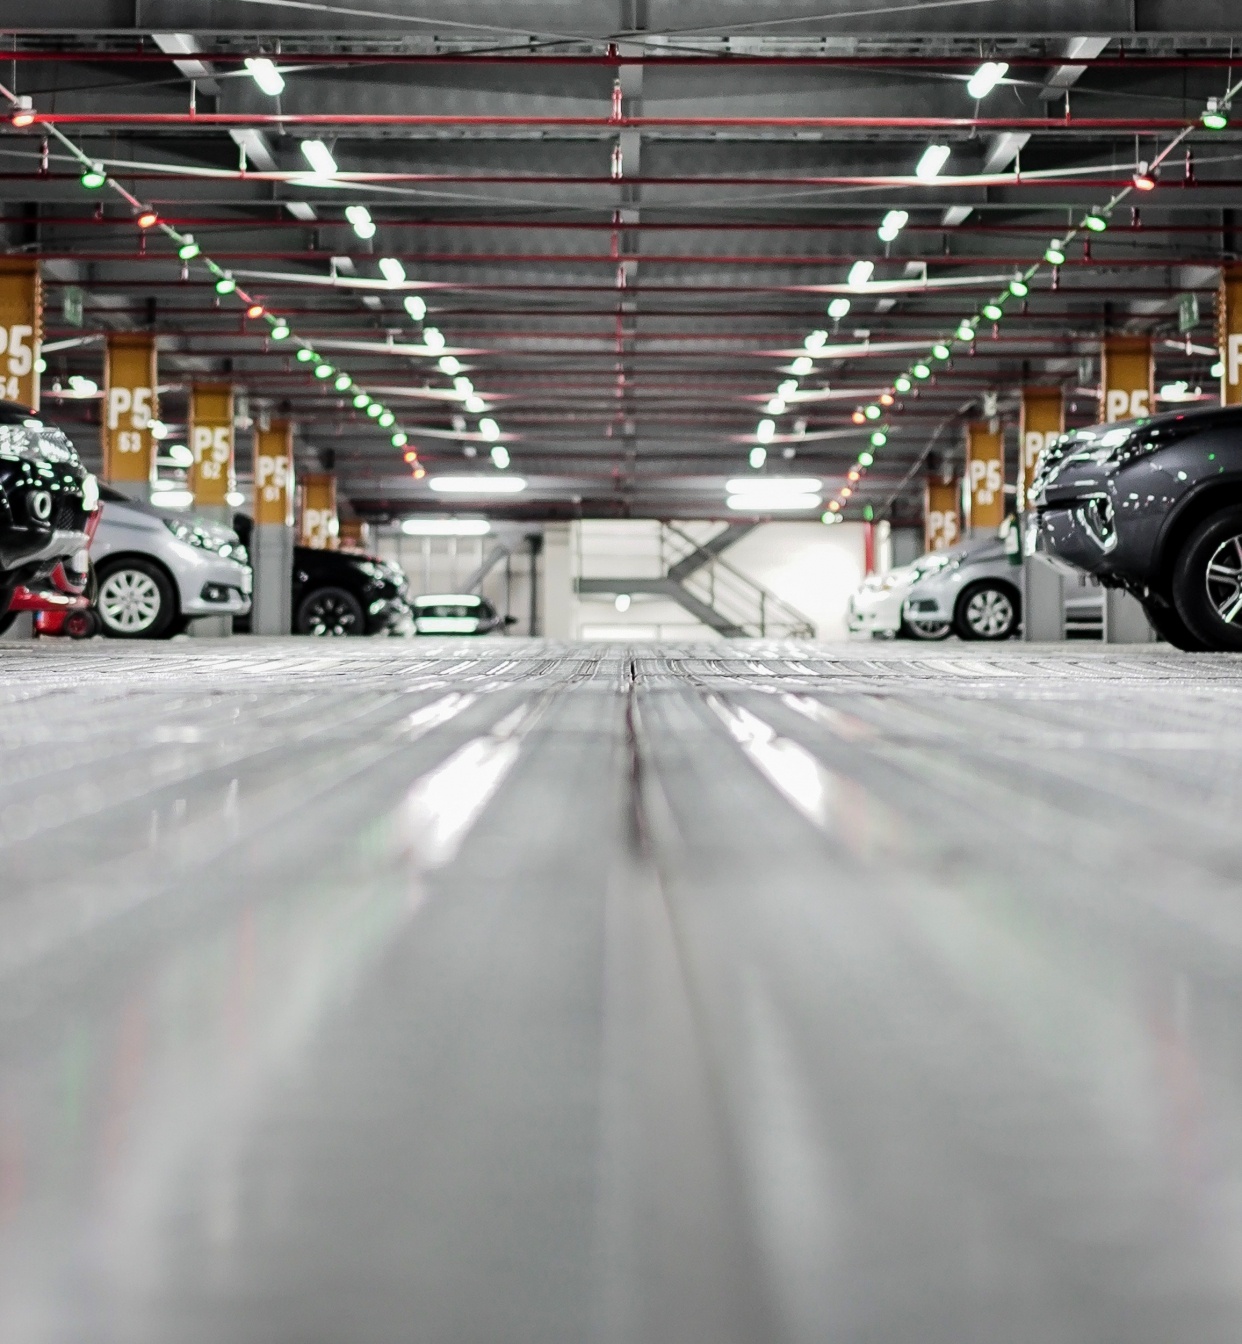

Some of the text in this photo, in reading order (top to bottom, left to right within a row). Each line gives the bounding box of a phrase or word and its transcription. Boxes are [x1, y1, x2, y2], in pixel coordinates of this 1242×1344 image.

[108, 387, 152, 430] P5
[193, 426, 230, 463] P5
[256, 455, 290, 488] P5
[970, 459, 1001, 492] P5
[929, 511, 956, 540] P5
